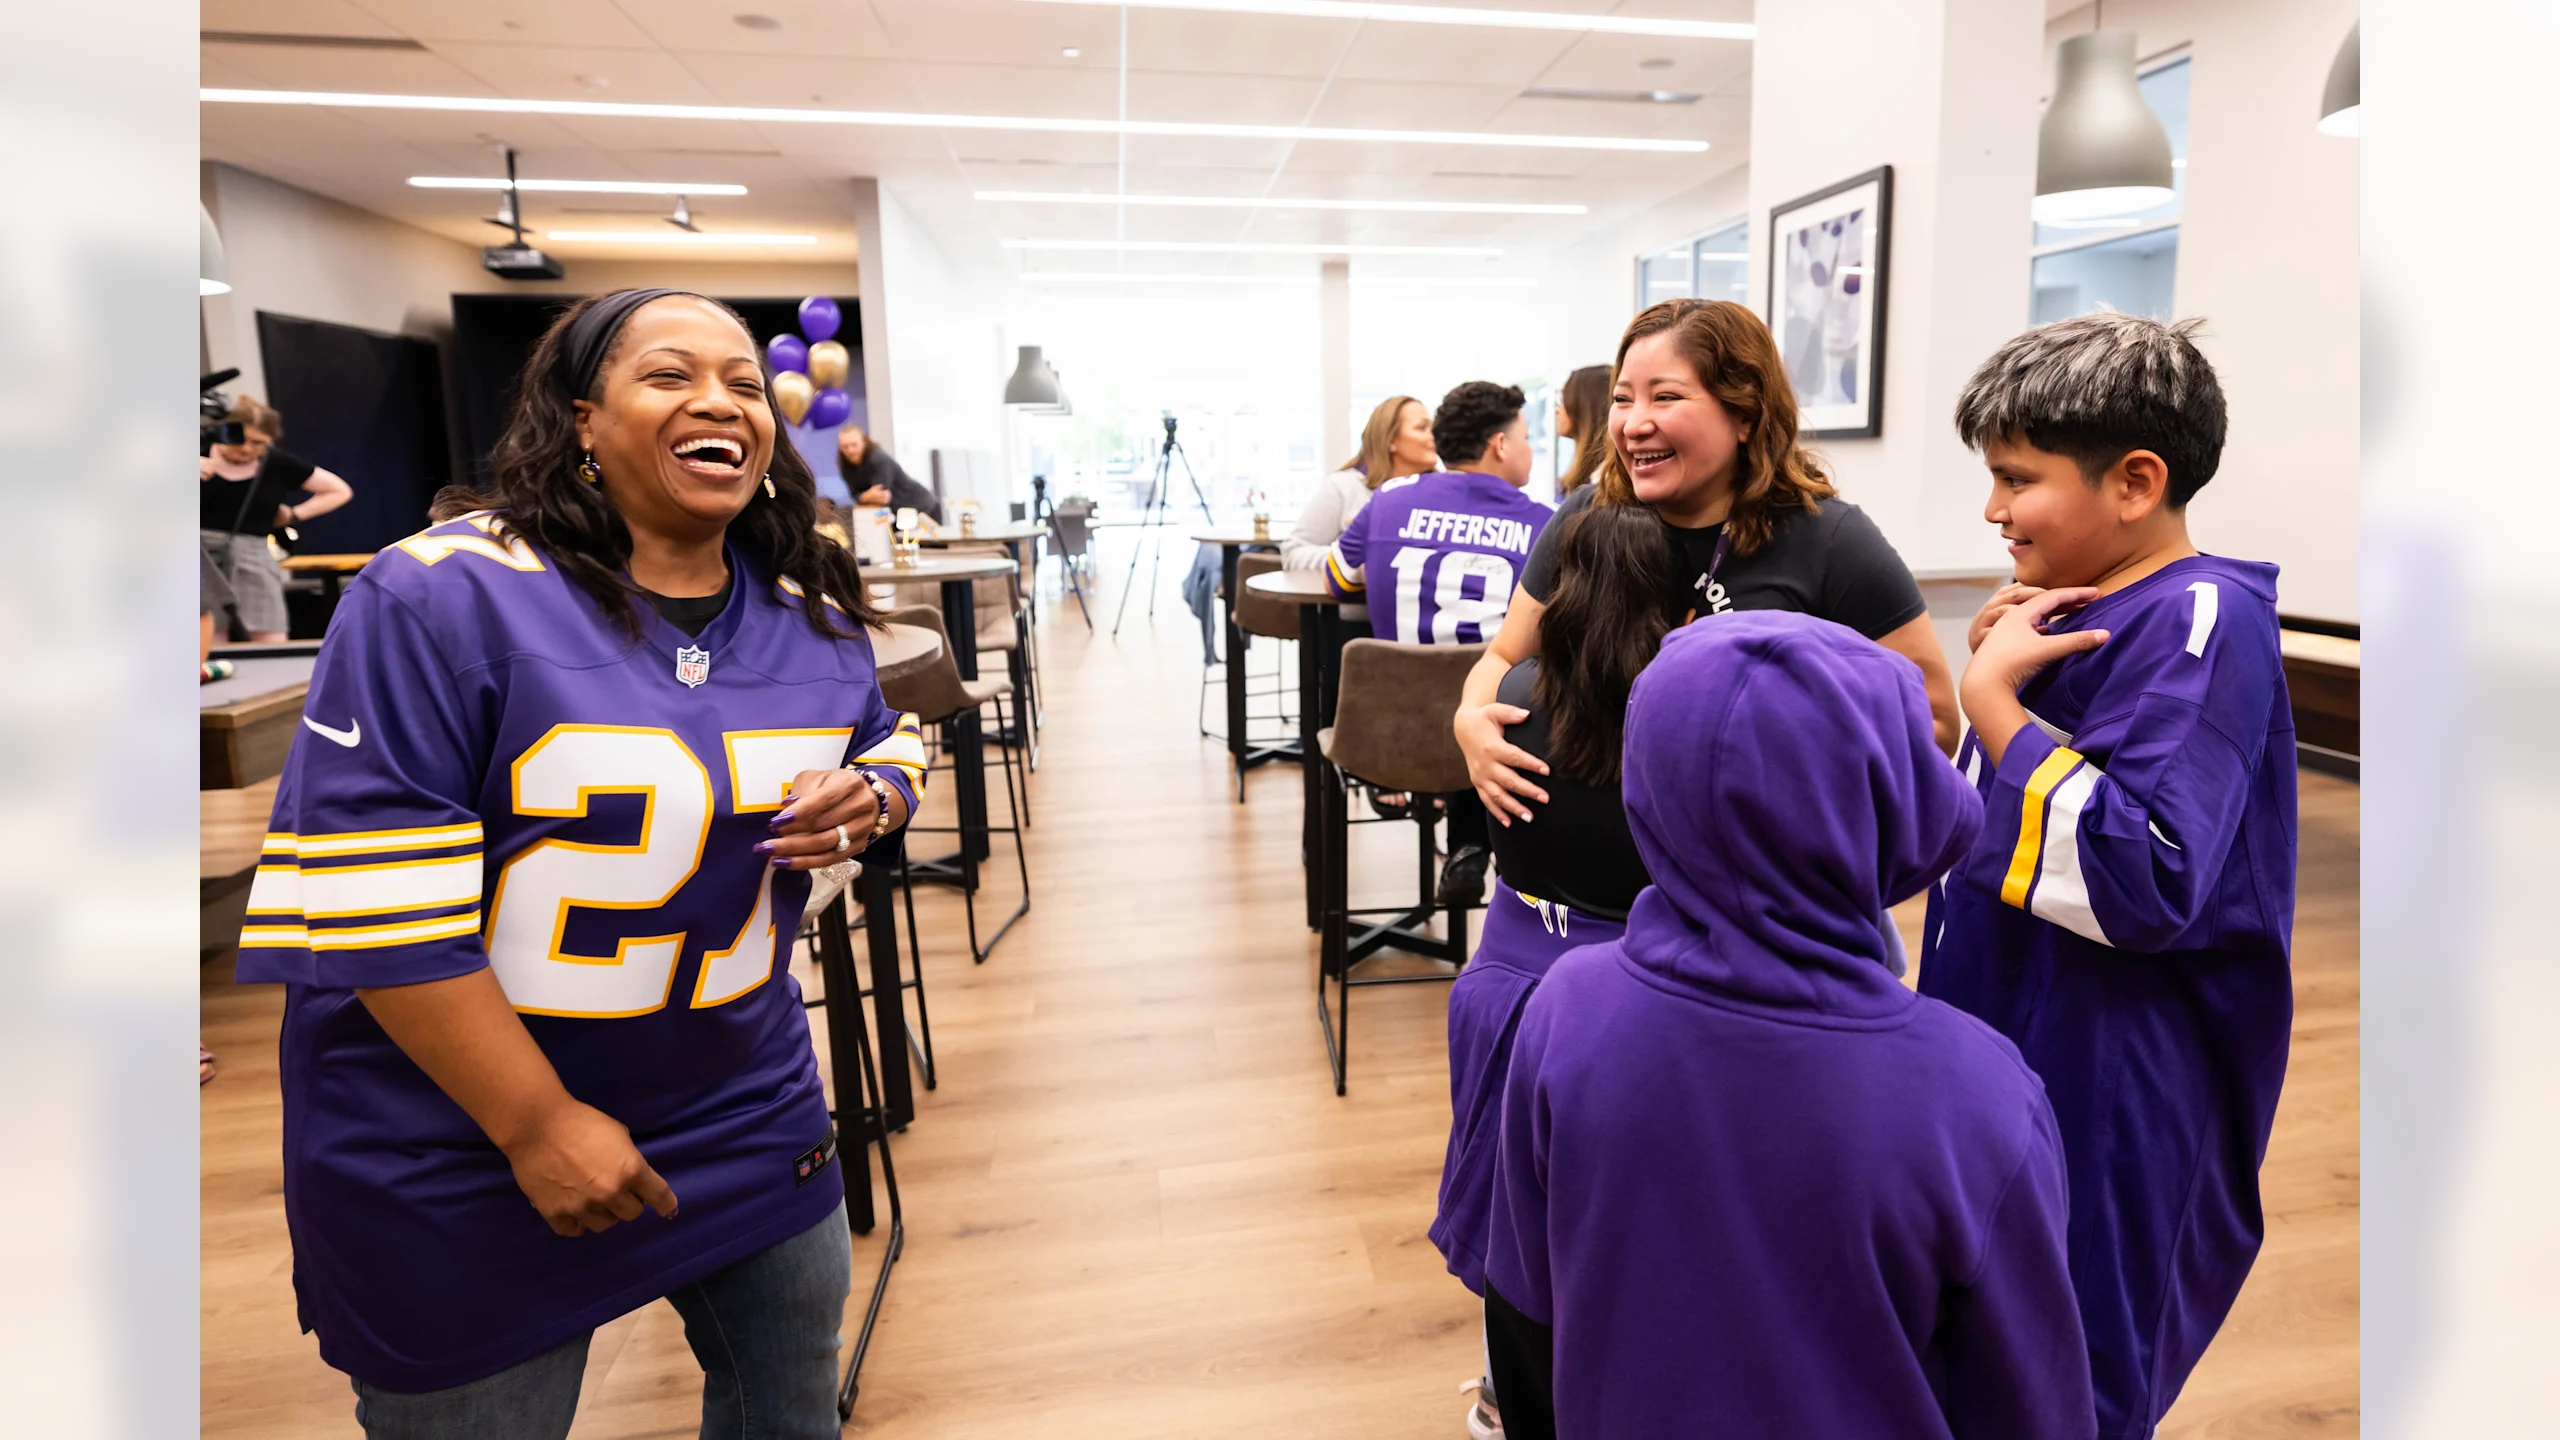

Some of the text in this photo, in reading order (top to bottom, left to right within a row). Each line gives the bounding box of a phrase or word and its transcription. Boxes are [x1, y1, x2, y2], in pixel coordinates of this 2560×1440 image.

[1398, 508, 1533, 555] JEFFERSON
[1390, 546, 1514, 645] 18
[2185, 581, 2219, 659] 1
[682, 662, 704, 681] NFL
[484, 722, 854, 1019] 27
